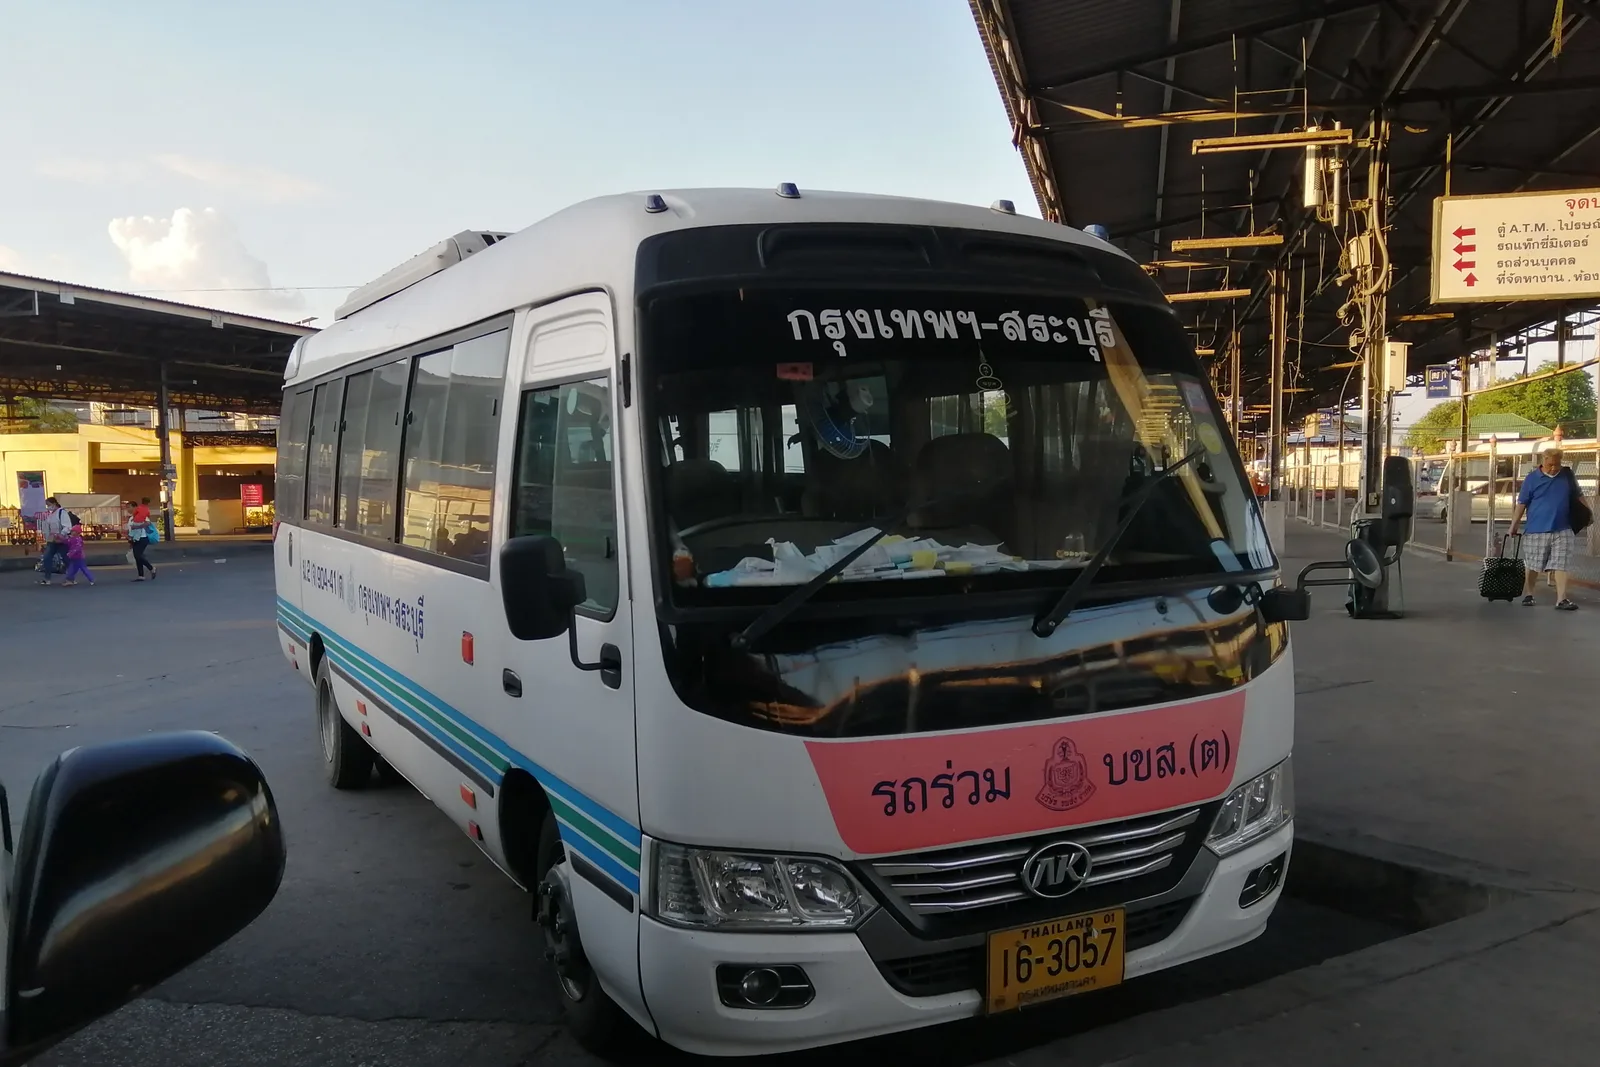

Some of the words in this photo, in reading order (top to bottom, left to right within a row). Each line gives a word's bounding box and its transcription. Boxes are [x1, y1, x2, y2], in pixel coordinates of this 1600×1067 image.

[1496, 256, 1576, 271] รถส่วนบุคคล
[786, 307, 1117, 362] กรุงเทพฯ-สระบุรี
[871, 760, 1011, 817] รถร่วม
[1021, 917, 1094, 939] THAILAND
[1003, 927, 1117, 988] 16-3057
